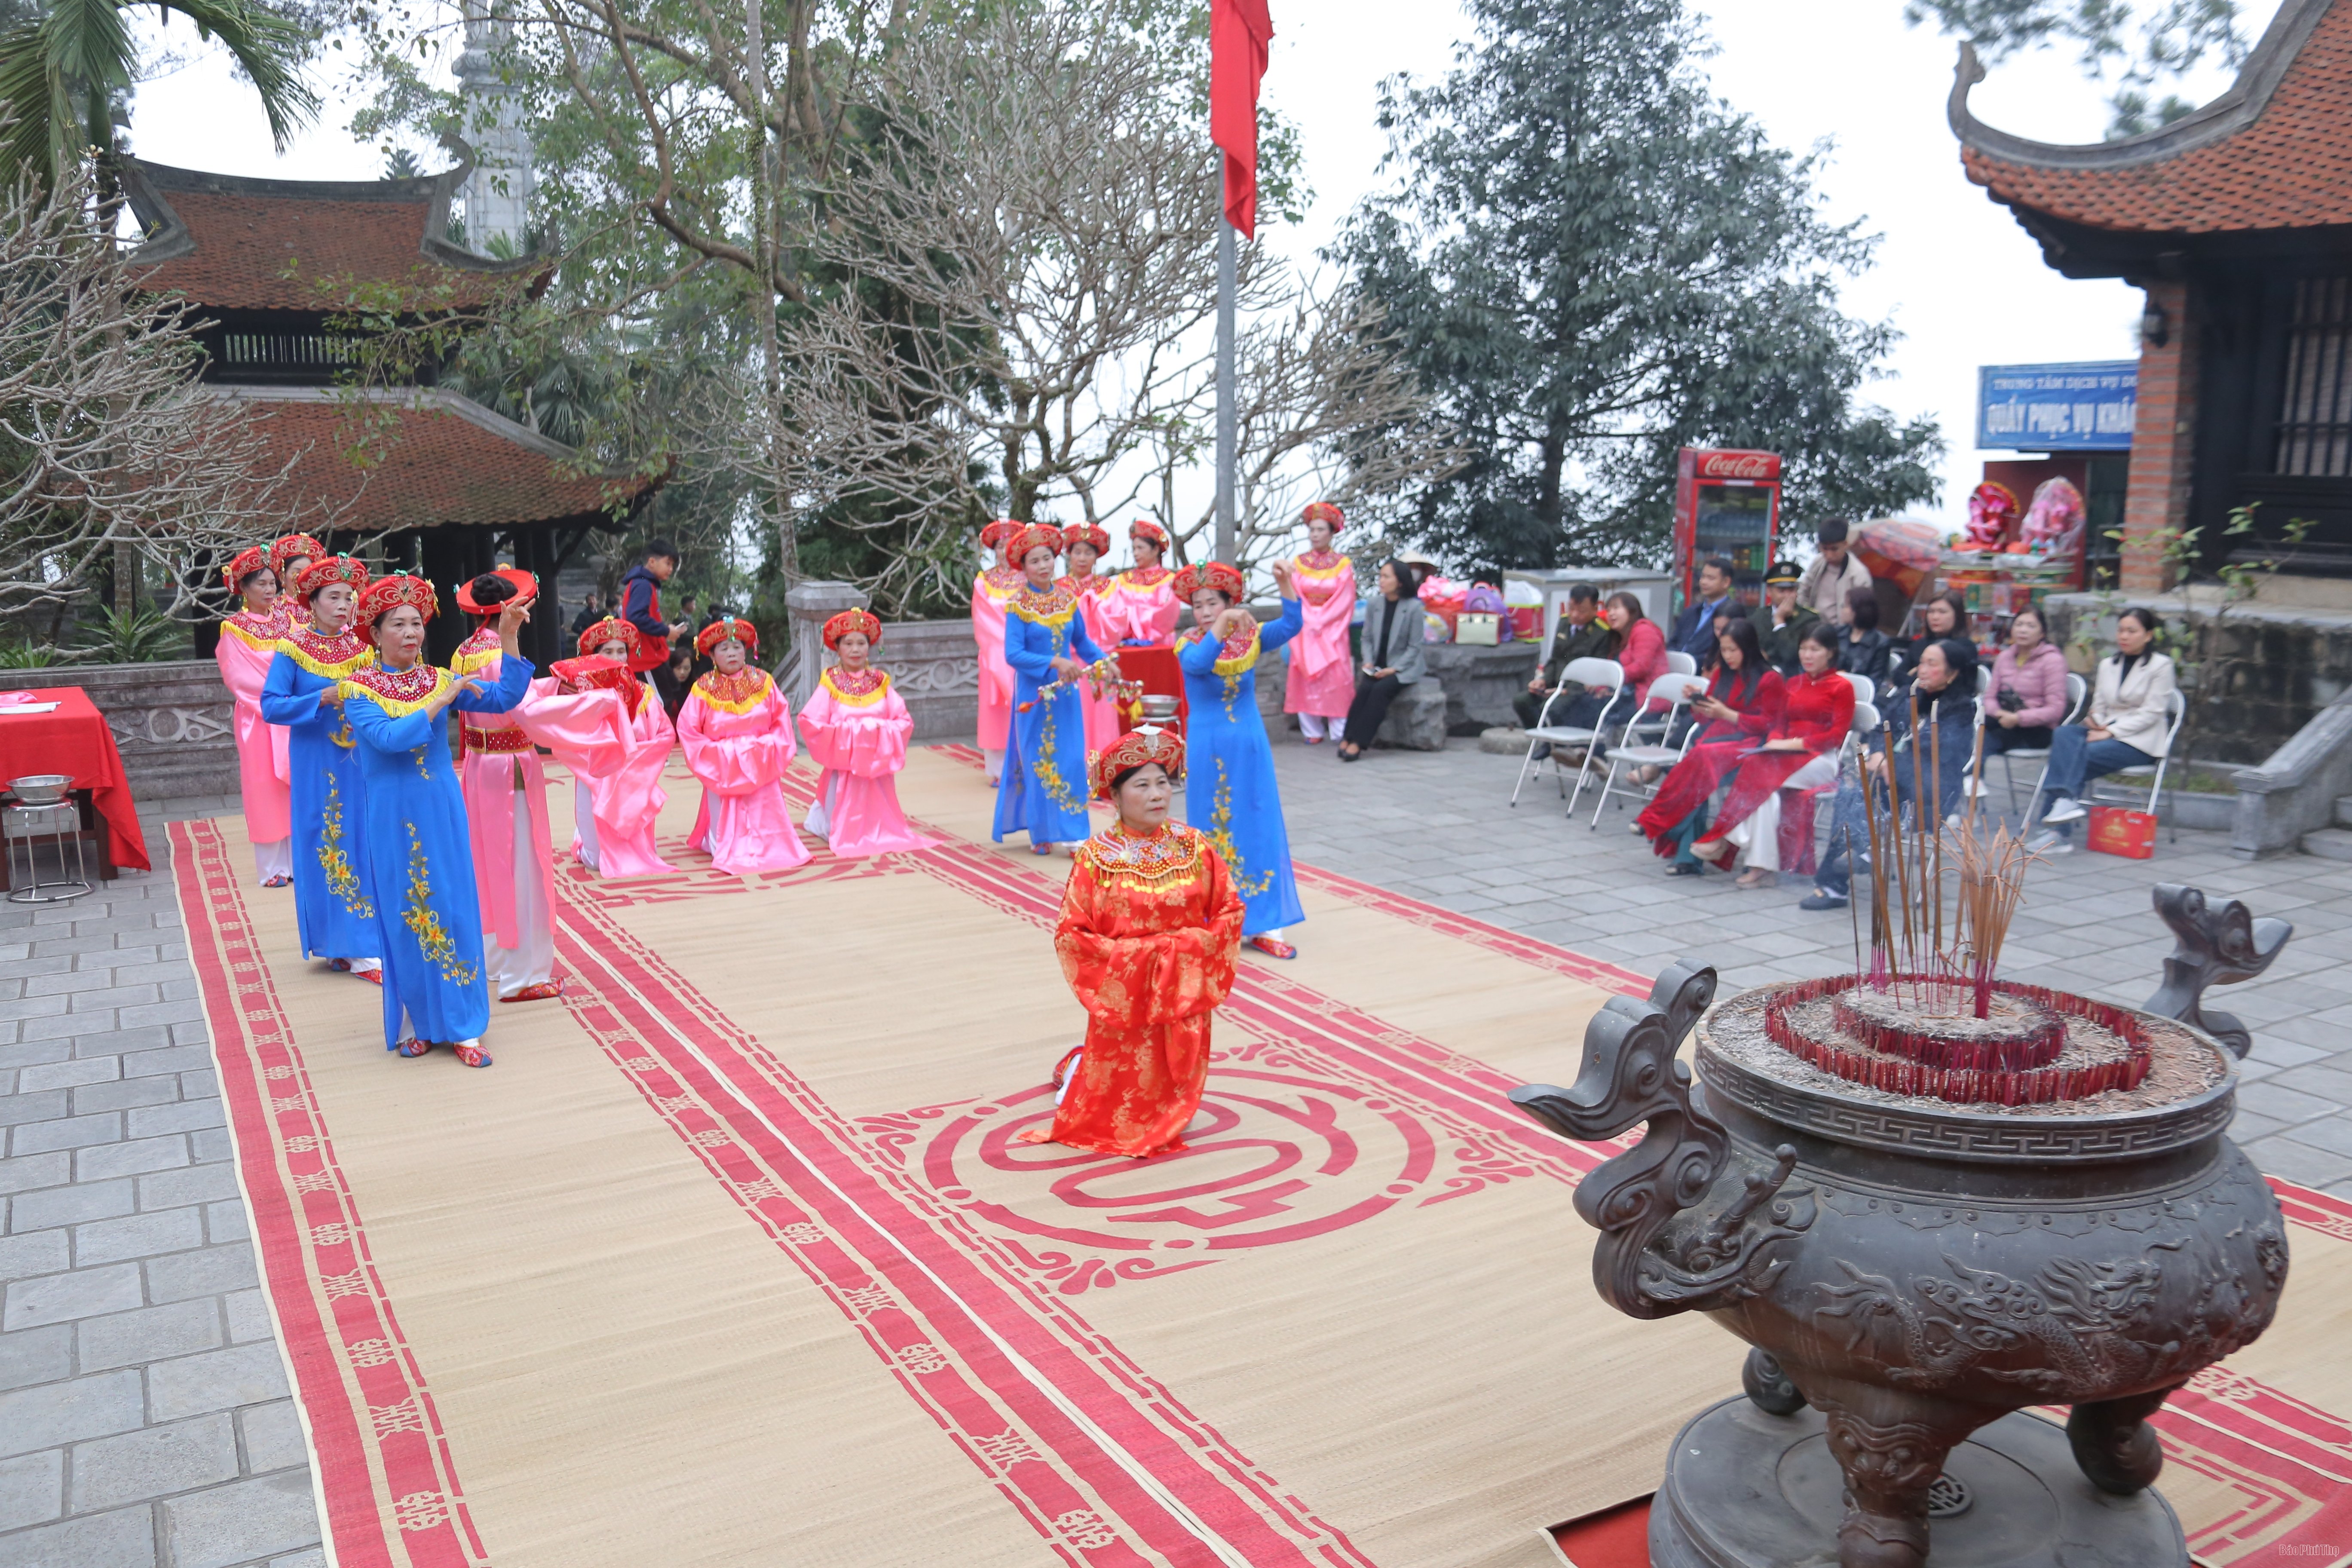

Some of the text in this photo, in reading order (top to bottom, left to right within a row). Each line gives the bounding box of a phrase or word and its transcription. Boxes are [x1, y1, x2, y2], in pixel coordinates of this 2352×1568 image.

[1994, 378, 2034, 390] TRUNG
[2065, 376, 2098, 391] DỊCH
[2100, 376, 2120, 390] VỤ
[2027, 402, 2070, 441] PHỤC
[2072, 403, 2095, 441] VỤ
